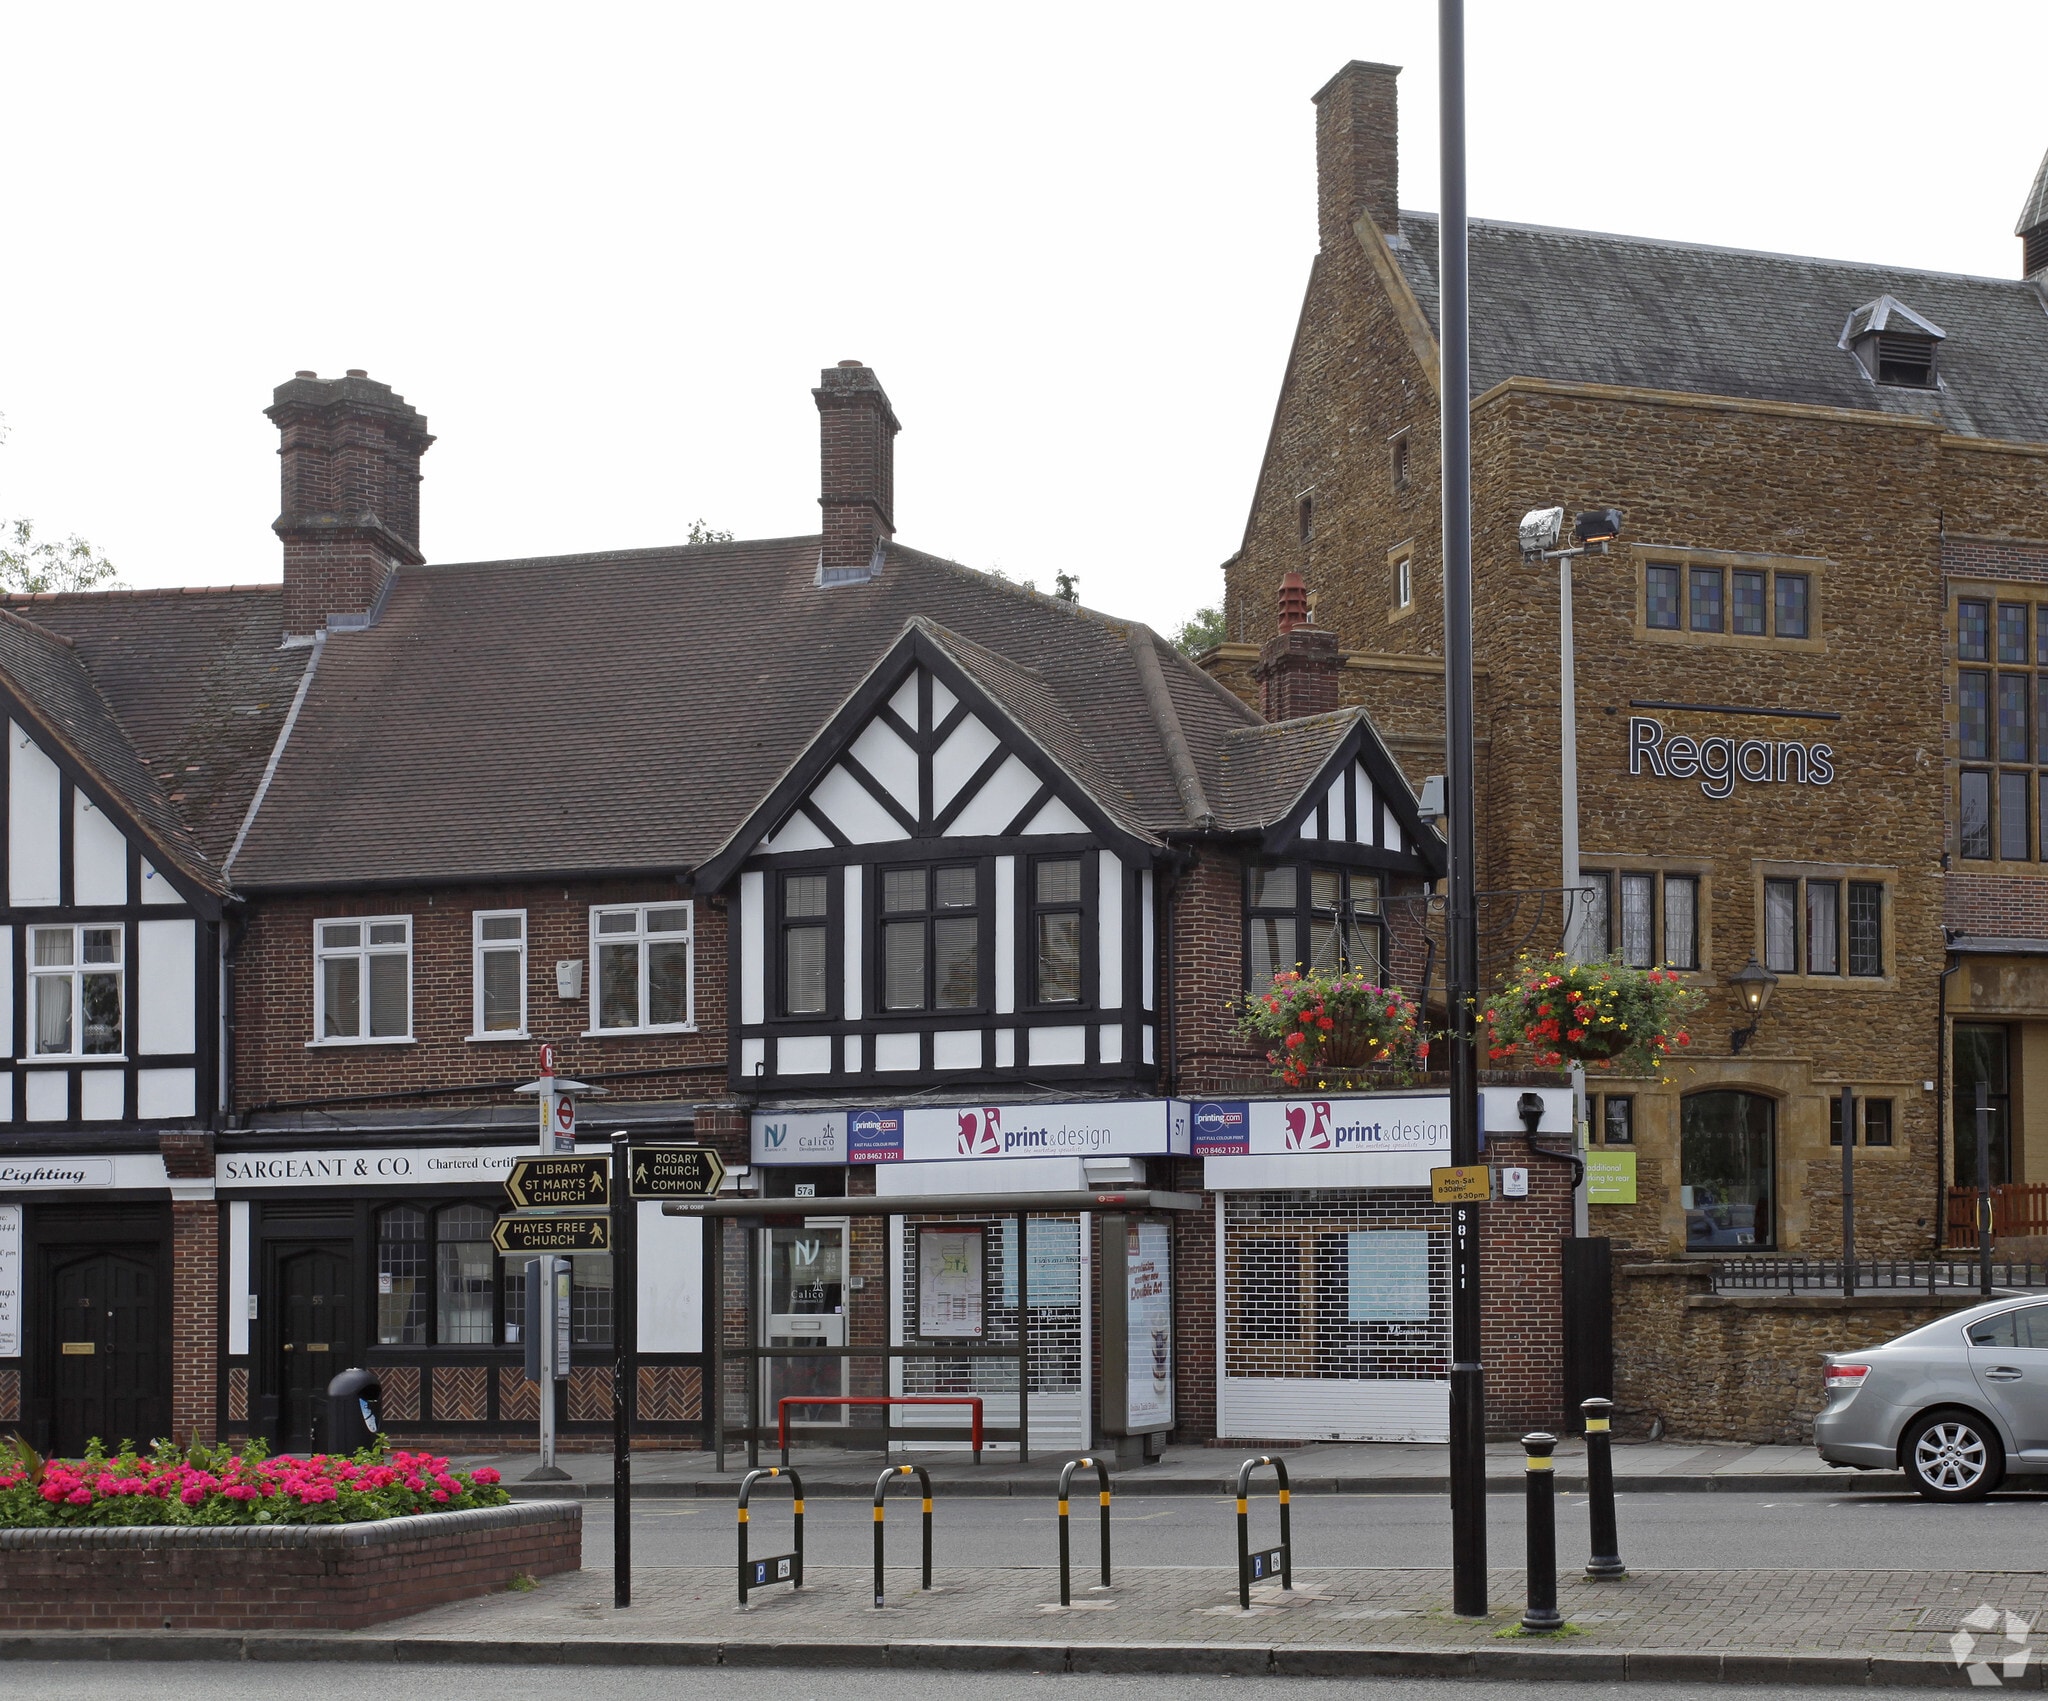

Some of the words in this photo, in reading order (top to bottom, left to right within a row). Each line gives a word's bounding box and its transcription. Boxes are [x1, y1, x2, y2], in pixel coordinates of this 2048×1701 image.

[1630, 717, 1834, 798] Regans
[546, 1047, 553, 1067] B
[1198, 1113, 1240, 1123] printing.com
[856, 1121, 896, 1131] printing.com
[1175, 1118, 1184, 1136] 57
[798, 1136, 835, 1146] Calico
[427, 1157, 478, 1170] Chartered
[482, 1156, 517, 1169] Certif
[656, 1153, 698, 1164] ROSARY
[226, 1158, 347, 1179] SARGEANT
[353, 1158, 368, 1176] &
[377, 1157, 413, 1176] CO.
[536, 1163, 586, 1175] LIBRARY
[653, 1165, 700, 1176] CHURCH
[0, 1167, 86, 1185] Lighting
[1444, 1177, 1475, 1185] Mon-Sat
[1607, 1174, 1614, 1182] to
[525, 1180, 539, 1190] ST
[543, 1178, 586, 1190] MARY'S
[651, 1180, 702, 1190] COMMON
[533, 1191, 586, 1202] CHURCH
[797, 1186, 813, 1196] 57a
[513, 1223, 552, 1234] HAYES
[556, 1222, 586, 1233] FREE
[523, 1234, 575, 1246] CHURCH
[791, 1289, 824, 1299] Calico
[1255, 1558, 1261, 1575] P
[758, 1565, 764, 1581] P
